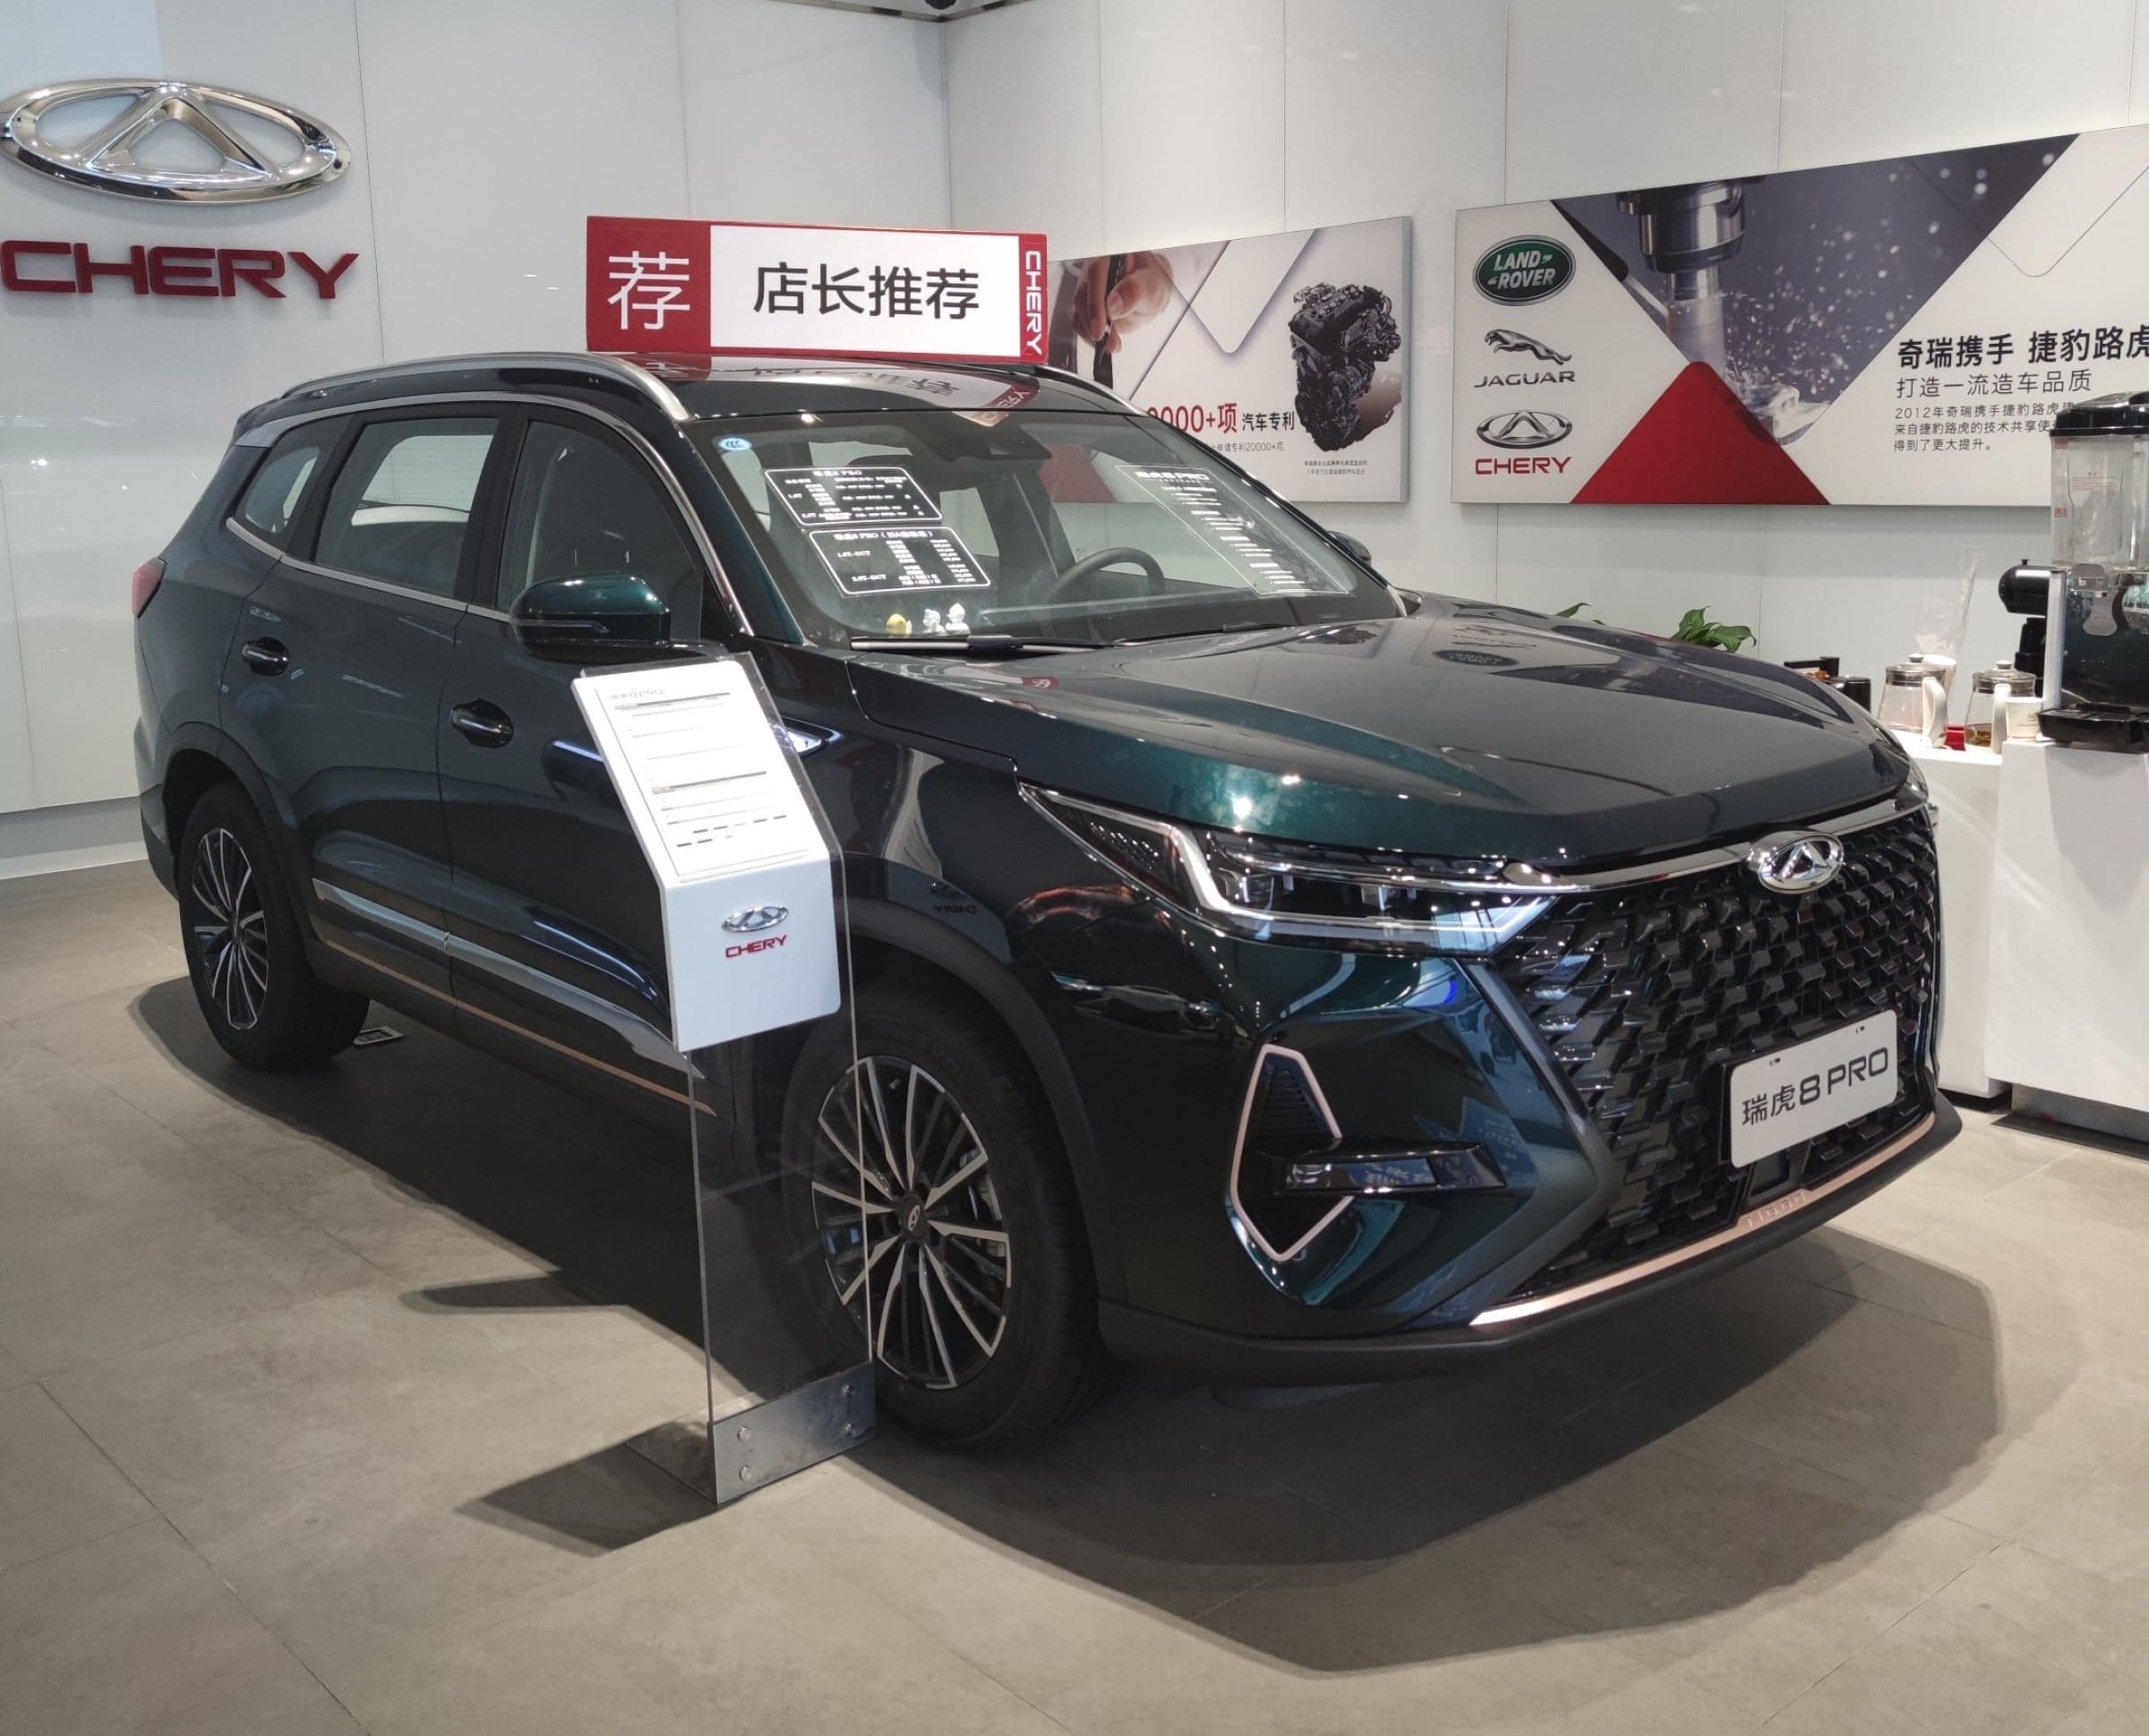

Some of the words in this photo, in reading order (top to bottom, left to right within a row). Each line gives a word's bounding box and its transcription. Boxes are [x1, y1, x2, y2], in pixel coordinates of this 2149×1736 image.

[1, 239, 360, 300] CHERY
[1494, 250, 1542, 271] LAND
[607, 250, 691, 330] 荐
[753, 261, 980, 321] 店长推荐
[1496, 269, 1556, 290] ROVER
[1025, 250, 1043, 356] CHERY
[1897, 332, 2014, 370] 奇瑞携手
[2028, 324, 2149, 363] 捷豹路虎
[1474, 371, 1576, 389] JAGUAR
[1896, 368, 2092, 399] 打造一流造车品质
[1241, 411, 1296, 432] 汽车专利
[1894, 420, 2057, 435] 来自捷豹路虎的技术共享使
[1894, 438, 1991, 452] 得到了更大提升。
[1475, 457, 1572, 475] CHERY
[724, 935, 788, 959] CHERY
[1742, 1073, 1821, 1126] 瑞虎8
[1827, 1046, 1889, 1097] PRO
